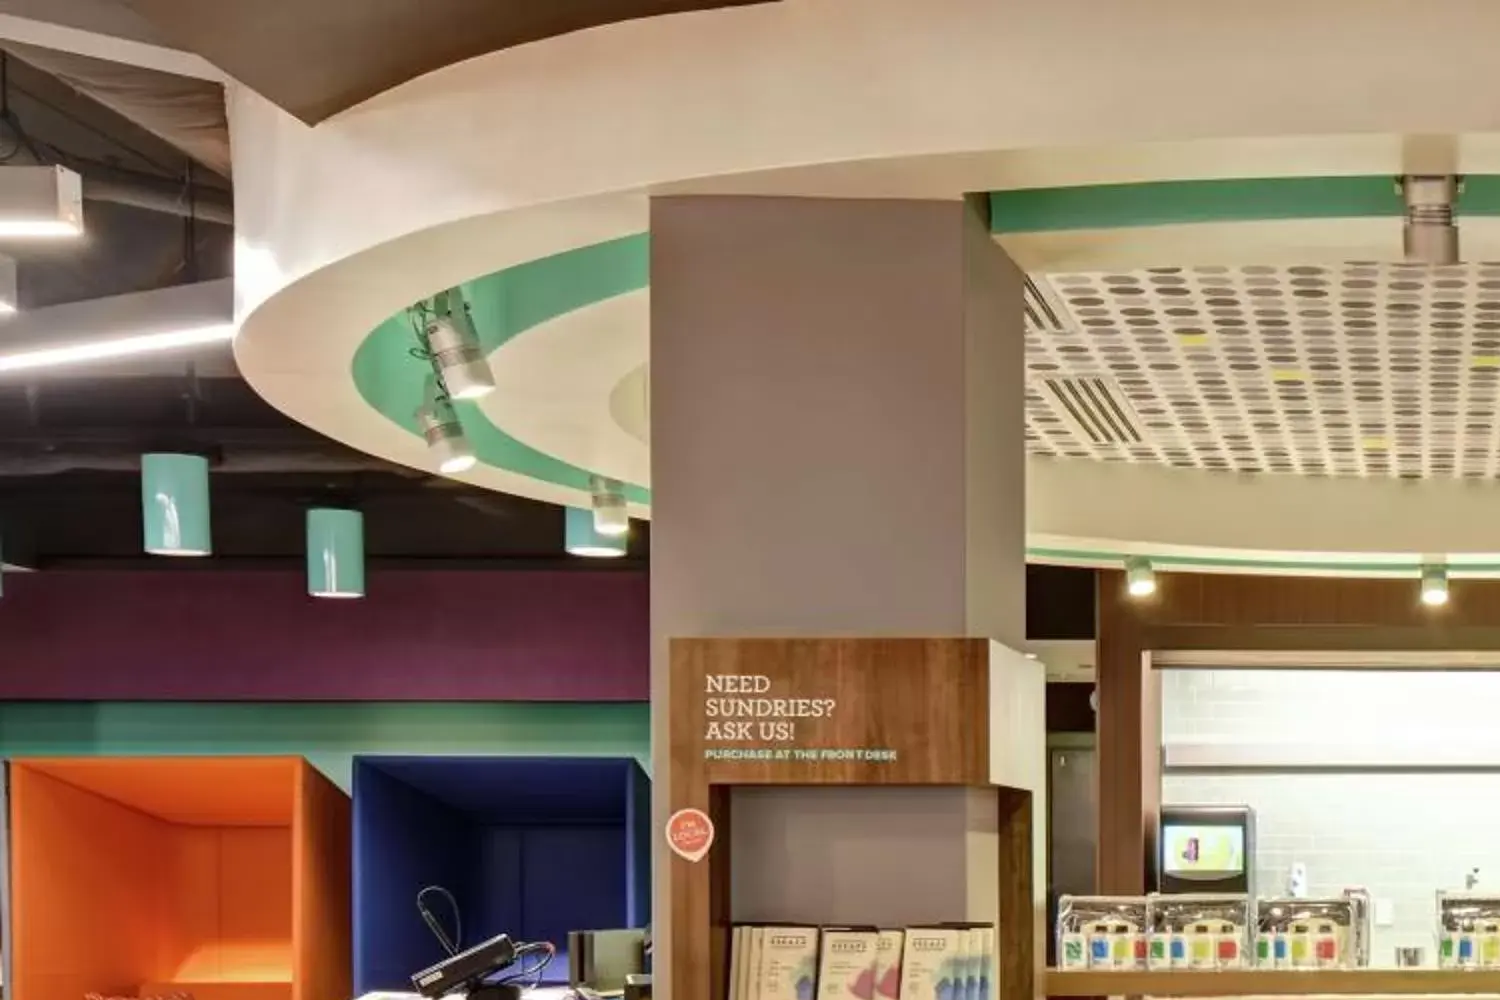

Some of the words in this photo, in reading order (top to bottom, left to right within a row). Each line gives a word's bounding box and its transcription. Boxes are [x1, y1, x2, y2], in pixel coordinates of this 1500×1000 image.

[705, 675, 771, 693] NEED
[705, 698, 836, 718] SUNDRIES?
[704, 720, 753, 741] ASK
[759, 720, 796, 741] US!
[704, 750, 771, 760] PURCHASE
[775, 750, 790, 760] AT
[795, 750, 818, 760] THE
[821, 750, 862, 760] FRONT
[865, 750, 897, 761] DESK
